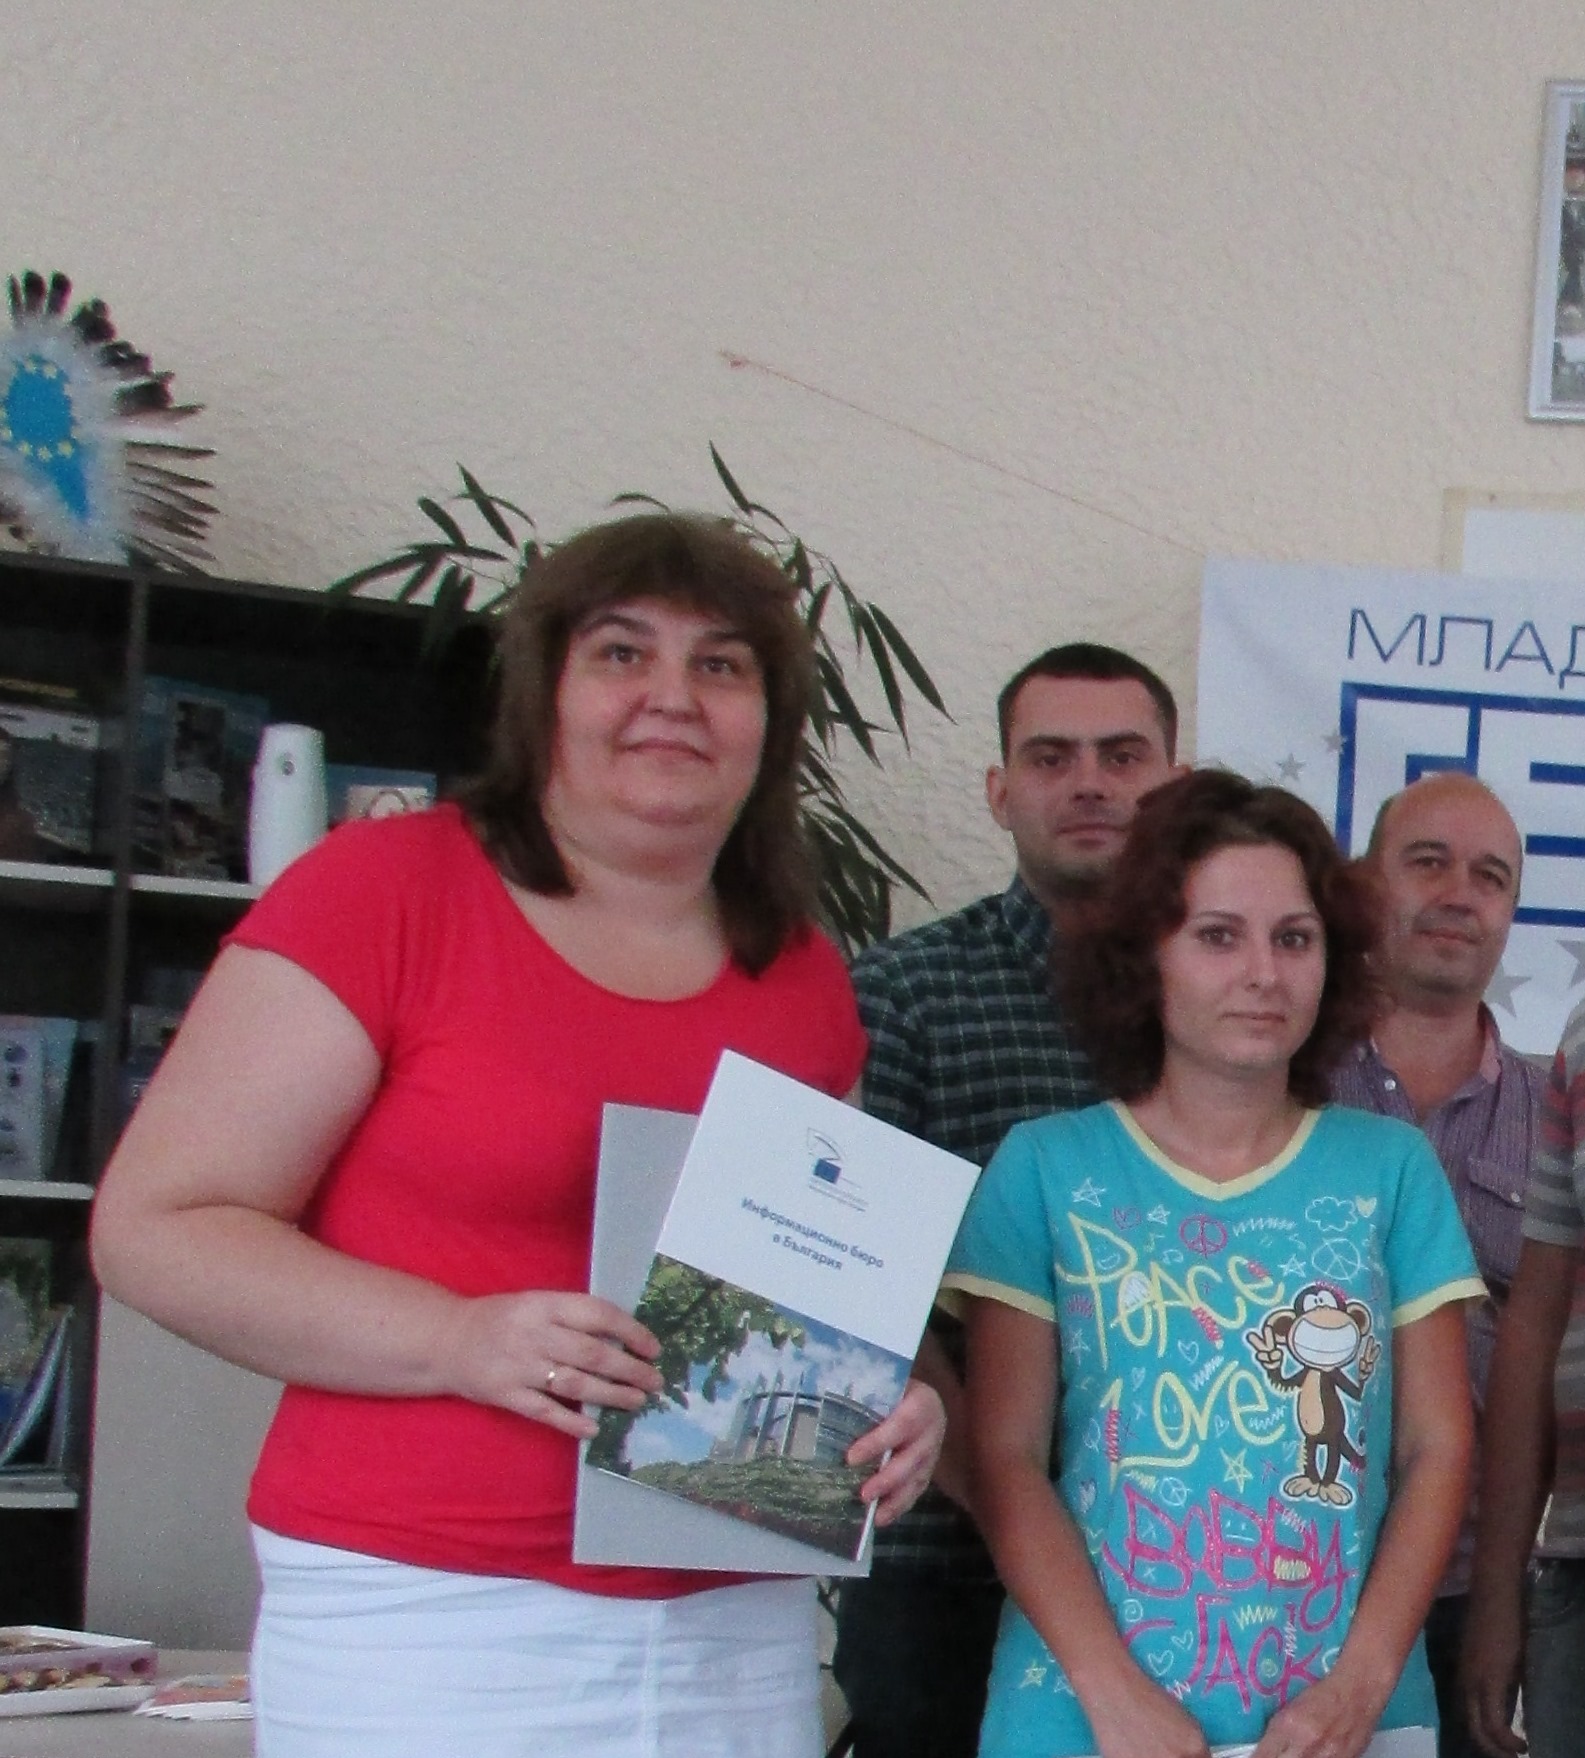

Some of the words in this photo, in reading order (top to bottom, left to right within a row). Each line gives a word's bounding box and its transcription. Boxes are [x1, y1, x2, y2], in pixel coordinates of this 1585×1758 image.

[741, 1197, 849, 1253] Информационно
[850, 1245, 884, 1268] бюро
[772, 1233, 781, 1243] в
[783, 1236, 843, 1270] България
